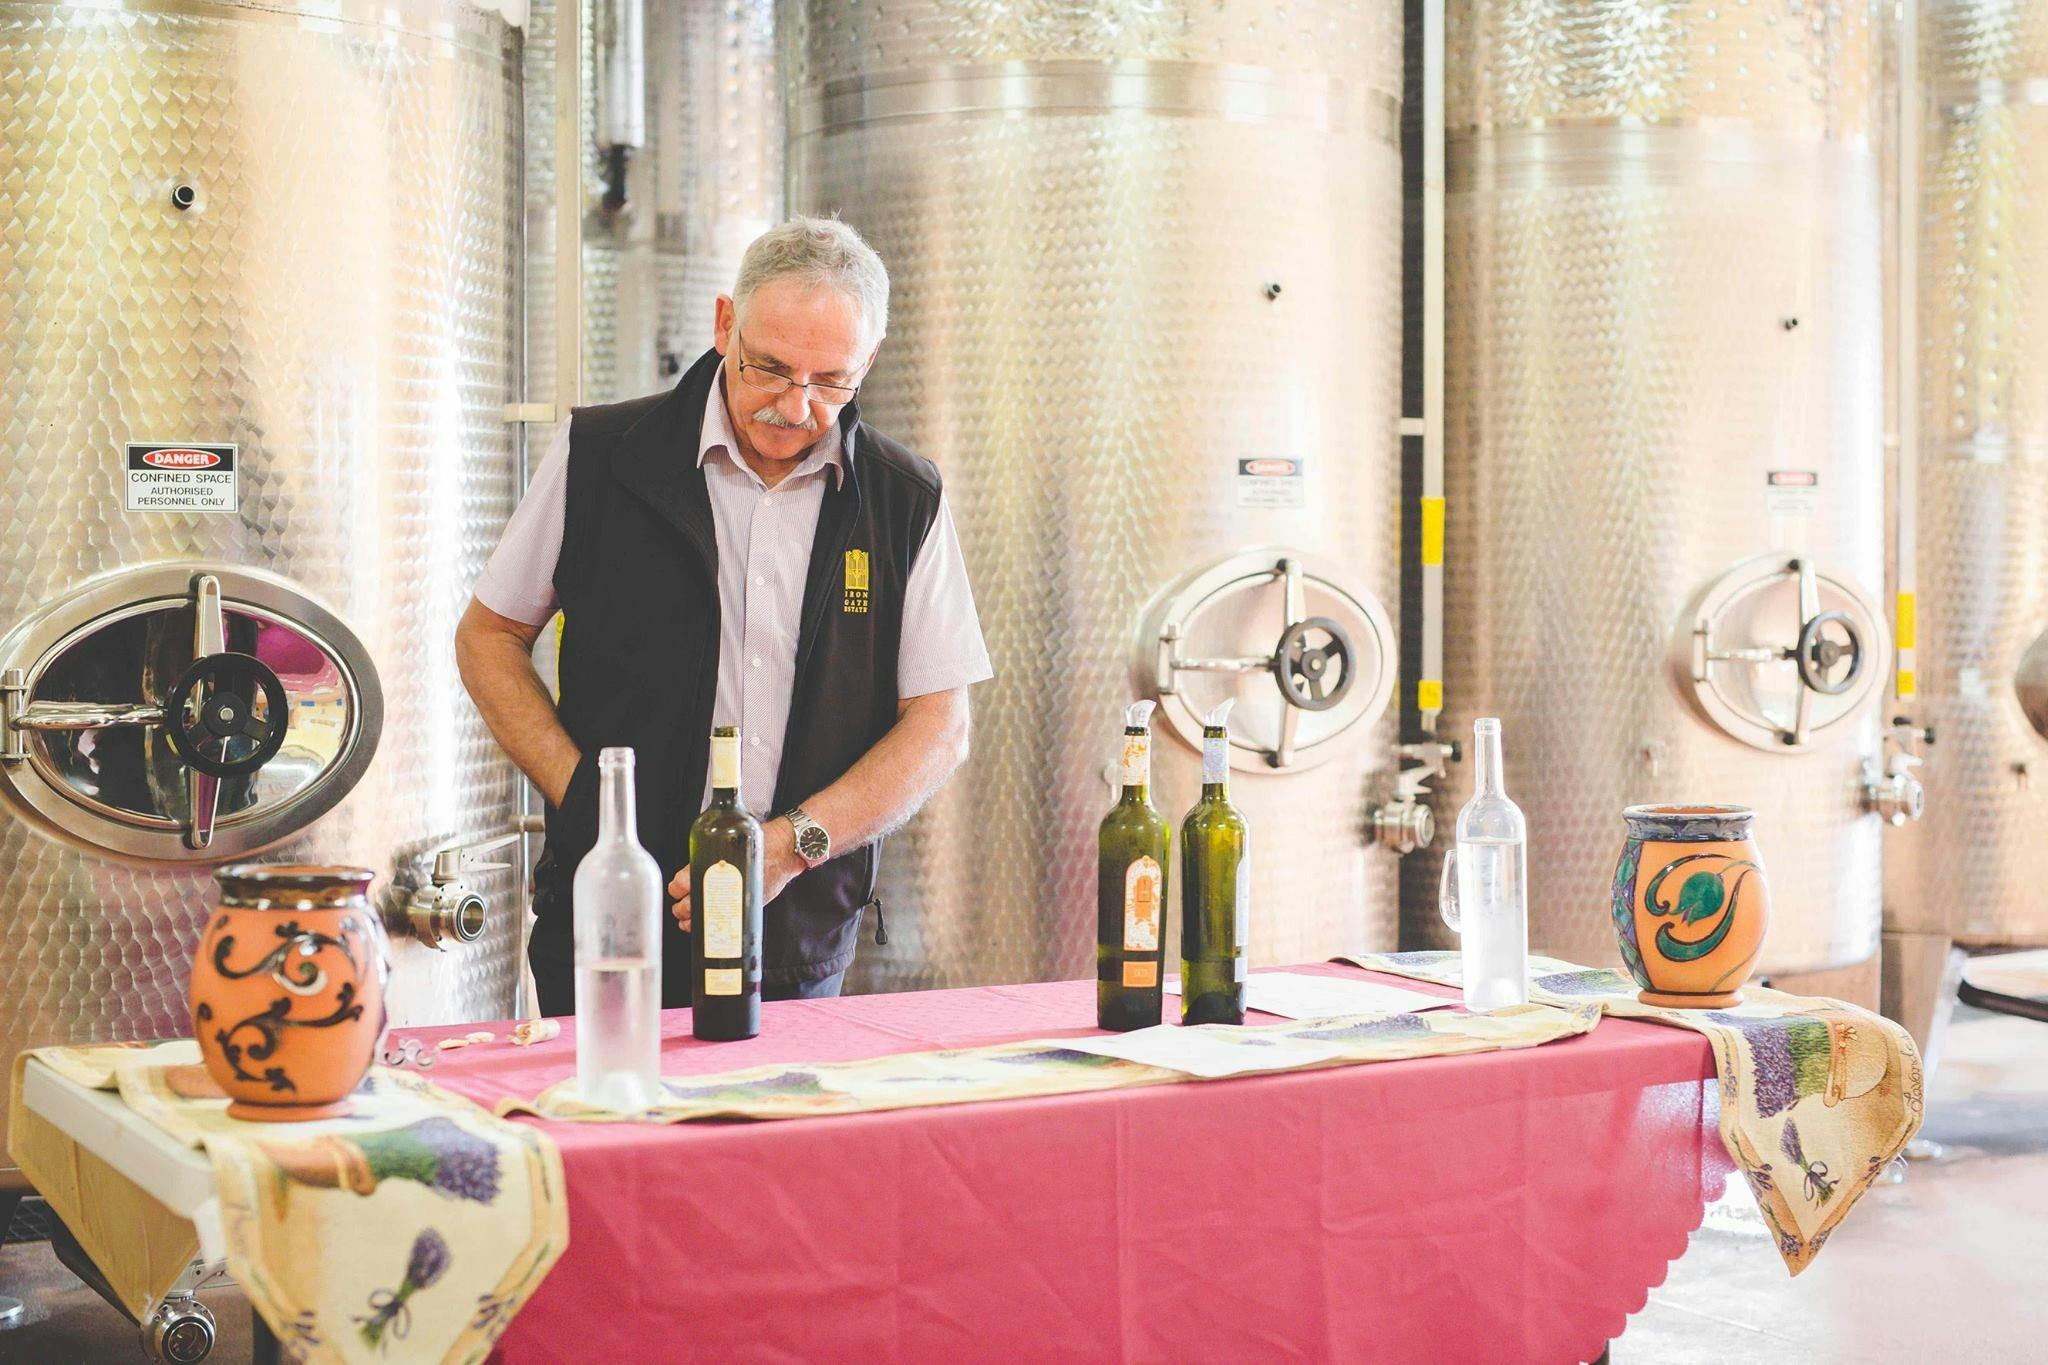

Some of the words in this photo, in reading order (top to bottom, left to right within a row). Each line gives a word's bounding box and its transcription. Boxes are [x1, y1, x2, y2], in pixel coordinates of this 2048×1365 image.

[154, 453, 210, 465] DANGER
[131, 472, 191, 483] CONFINED
[195, 473, 232, 484] SPACE
[150, 487, 214, 496] AUTHORISED
[137, 497, 197, 506] PERSONNEL
[201, 497, 225, 506] ONLY
[844, 590, 869, 598] IRON
